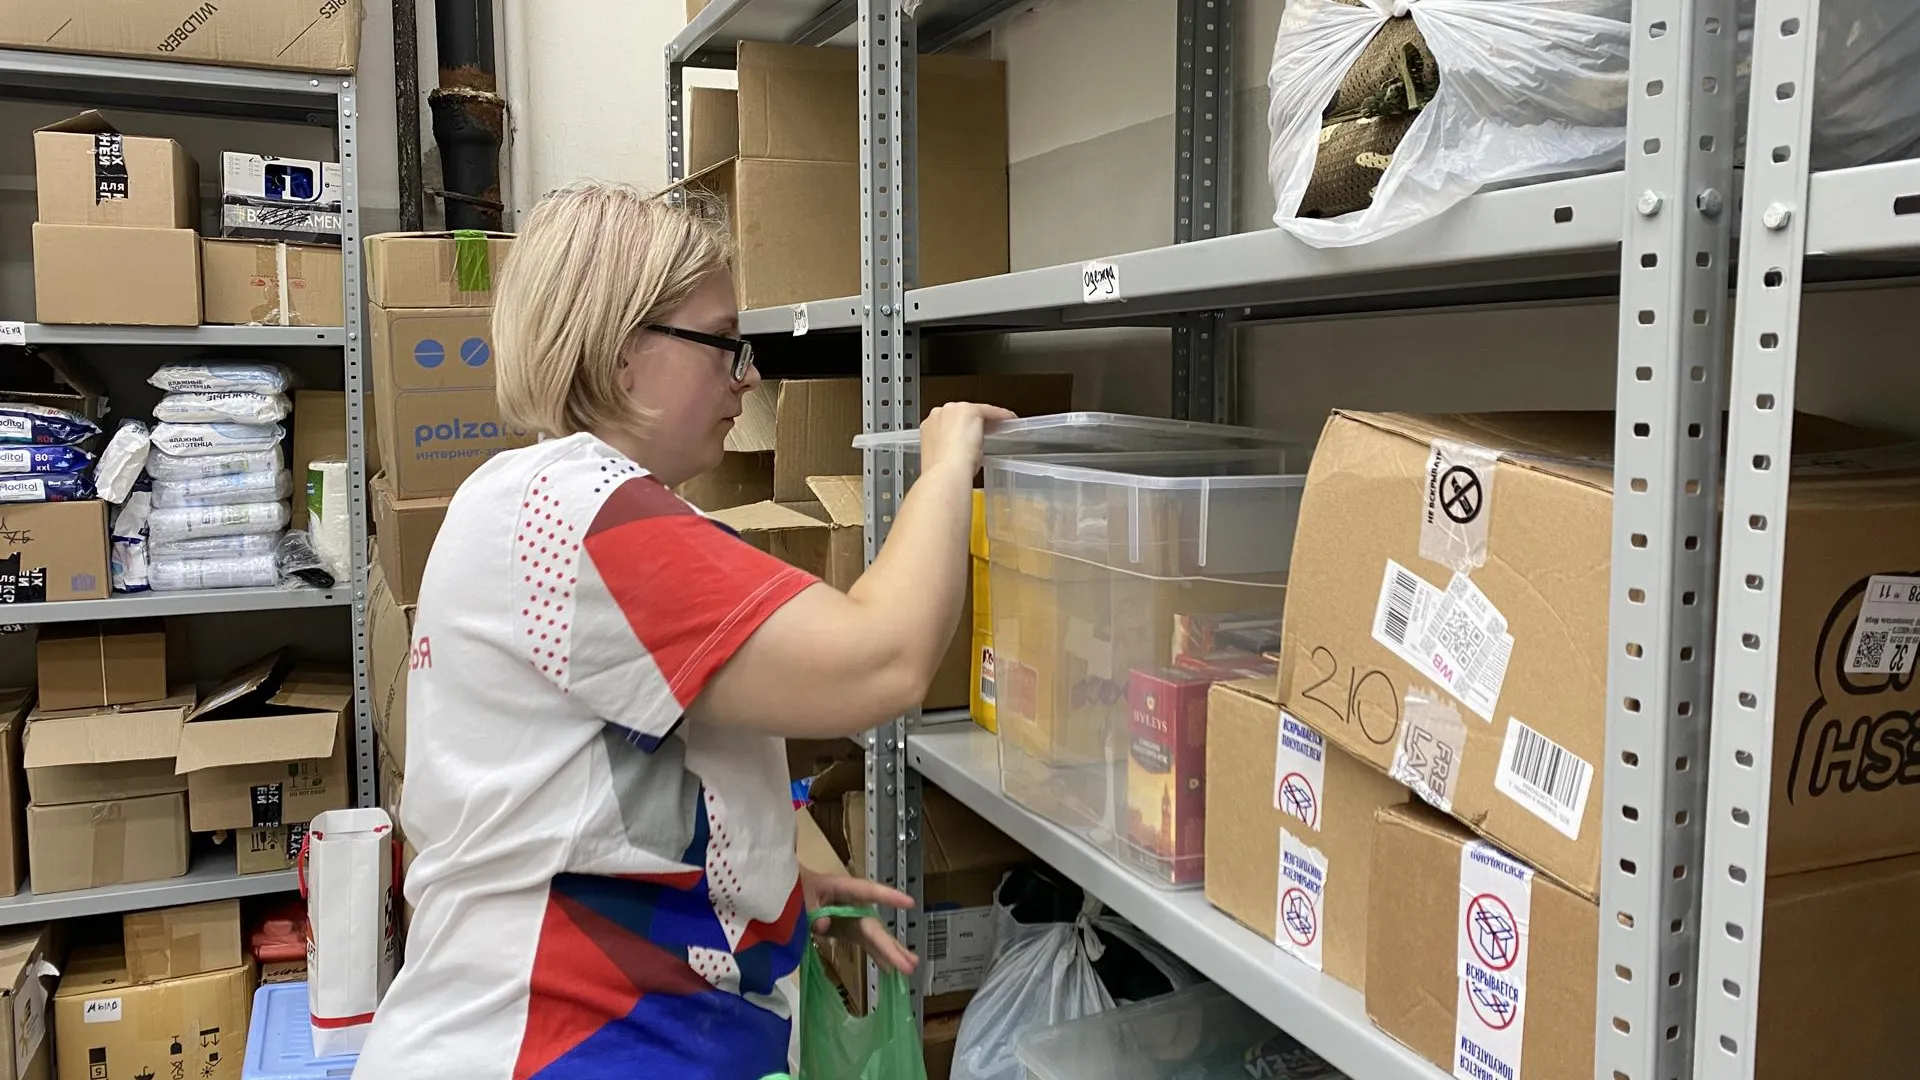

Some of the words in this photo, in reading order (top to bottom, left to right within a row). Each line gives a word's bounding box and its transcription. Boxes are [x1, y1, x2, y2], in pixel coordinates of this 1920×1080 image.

[1432, 653, 1454, 683] WB
[1889, 644, 1909, 672] 32
[1302, 646, 1399, 745] 210
[1133, 709, 1168, 733] HYLEYS
[1466, 962, 1519, 1004] ВСКРЫВАЕТСЯ
[1461, 1036, 1514, 1080] ПОКУПАТЕЛЕМ
